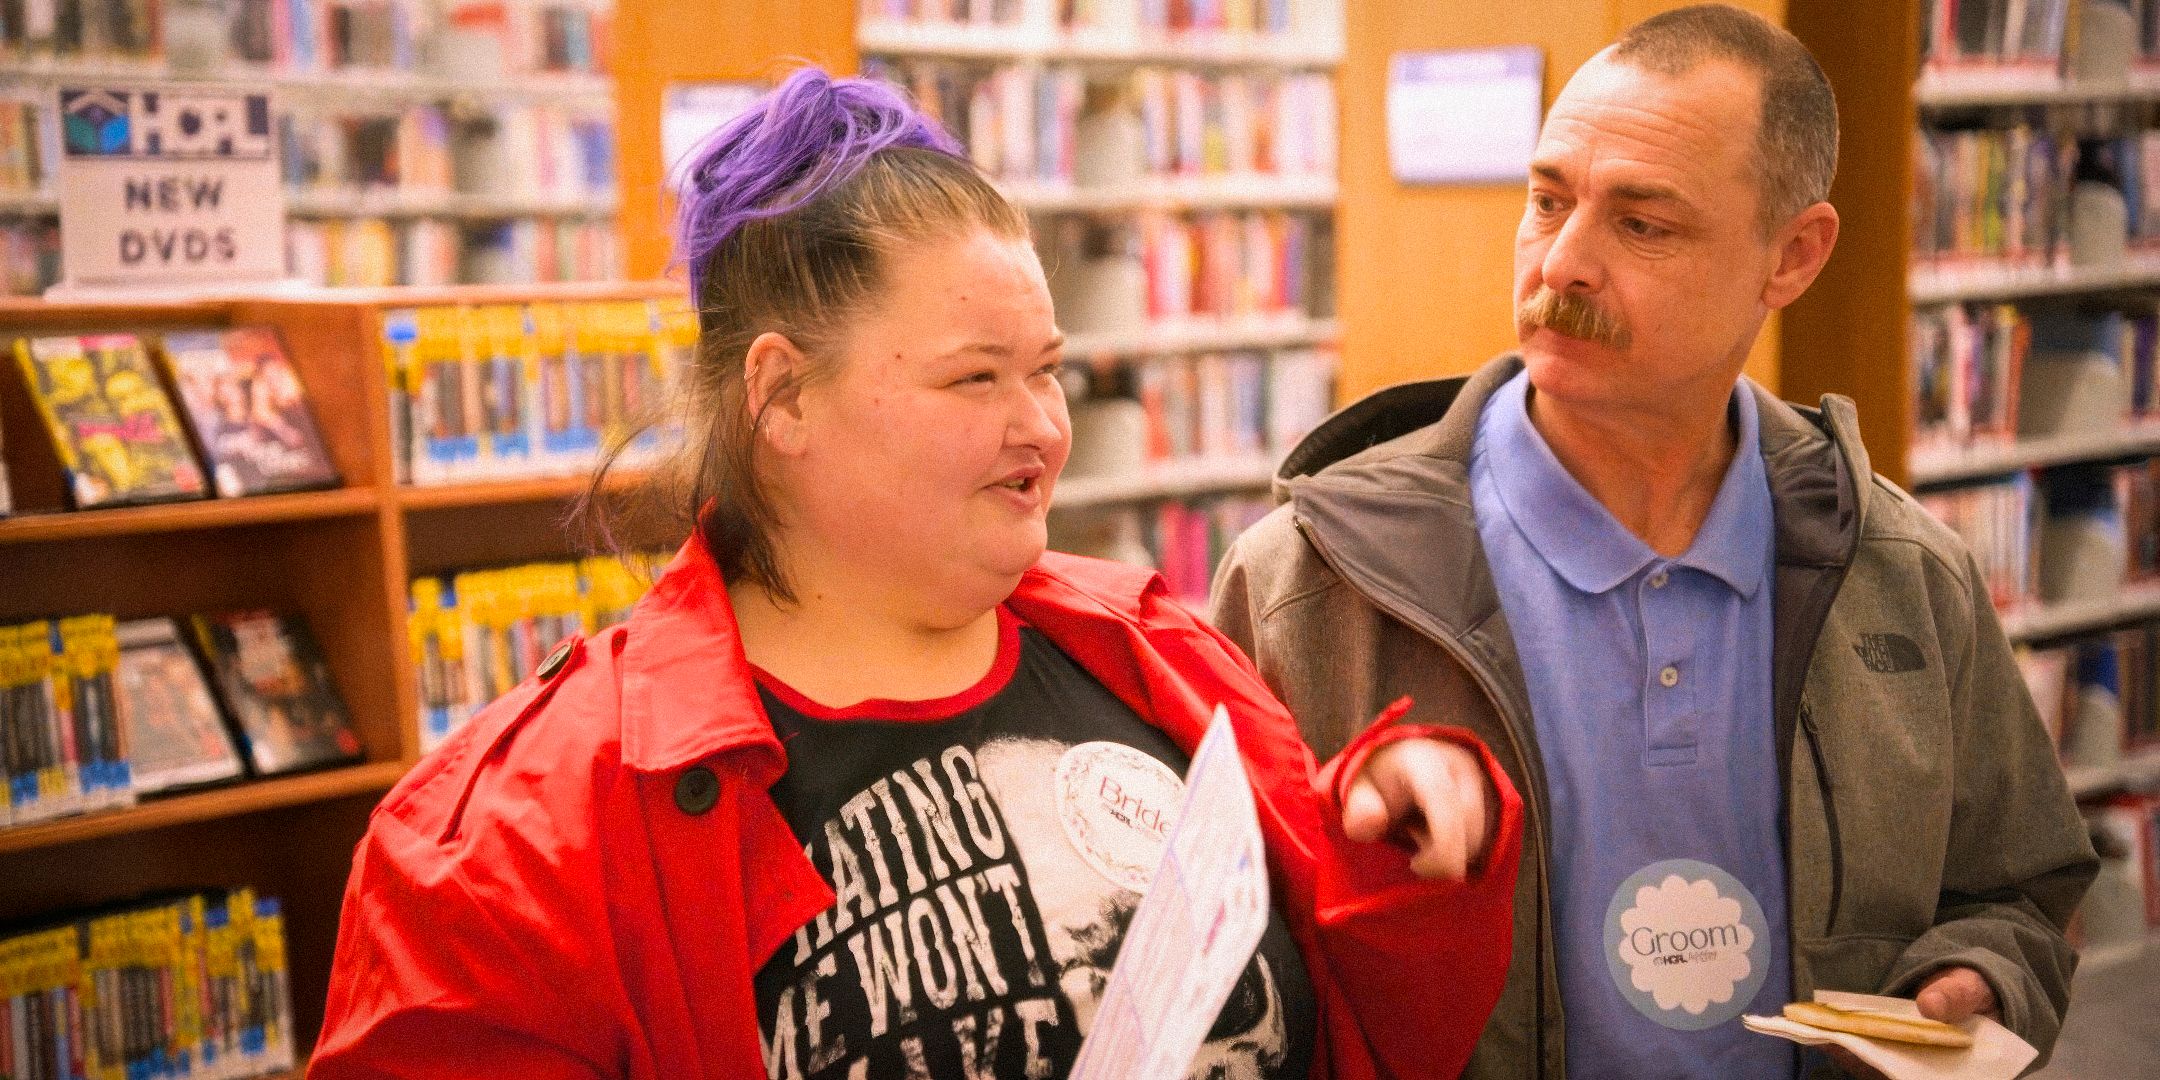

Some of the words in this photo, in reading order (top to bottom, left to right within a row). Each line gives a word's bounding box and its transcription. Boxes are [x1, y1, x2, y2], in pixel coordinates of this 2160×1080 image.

[125, 177, 223, 210] NEW
[847, 863, 1046, 1038] WON'T
[1631, 923, 1739, 956] Groom
